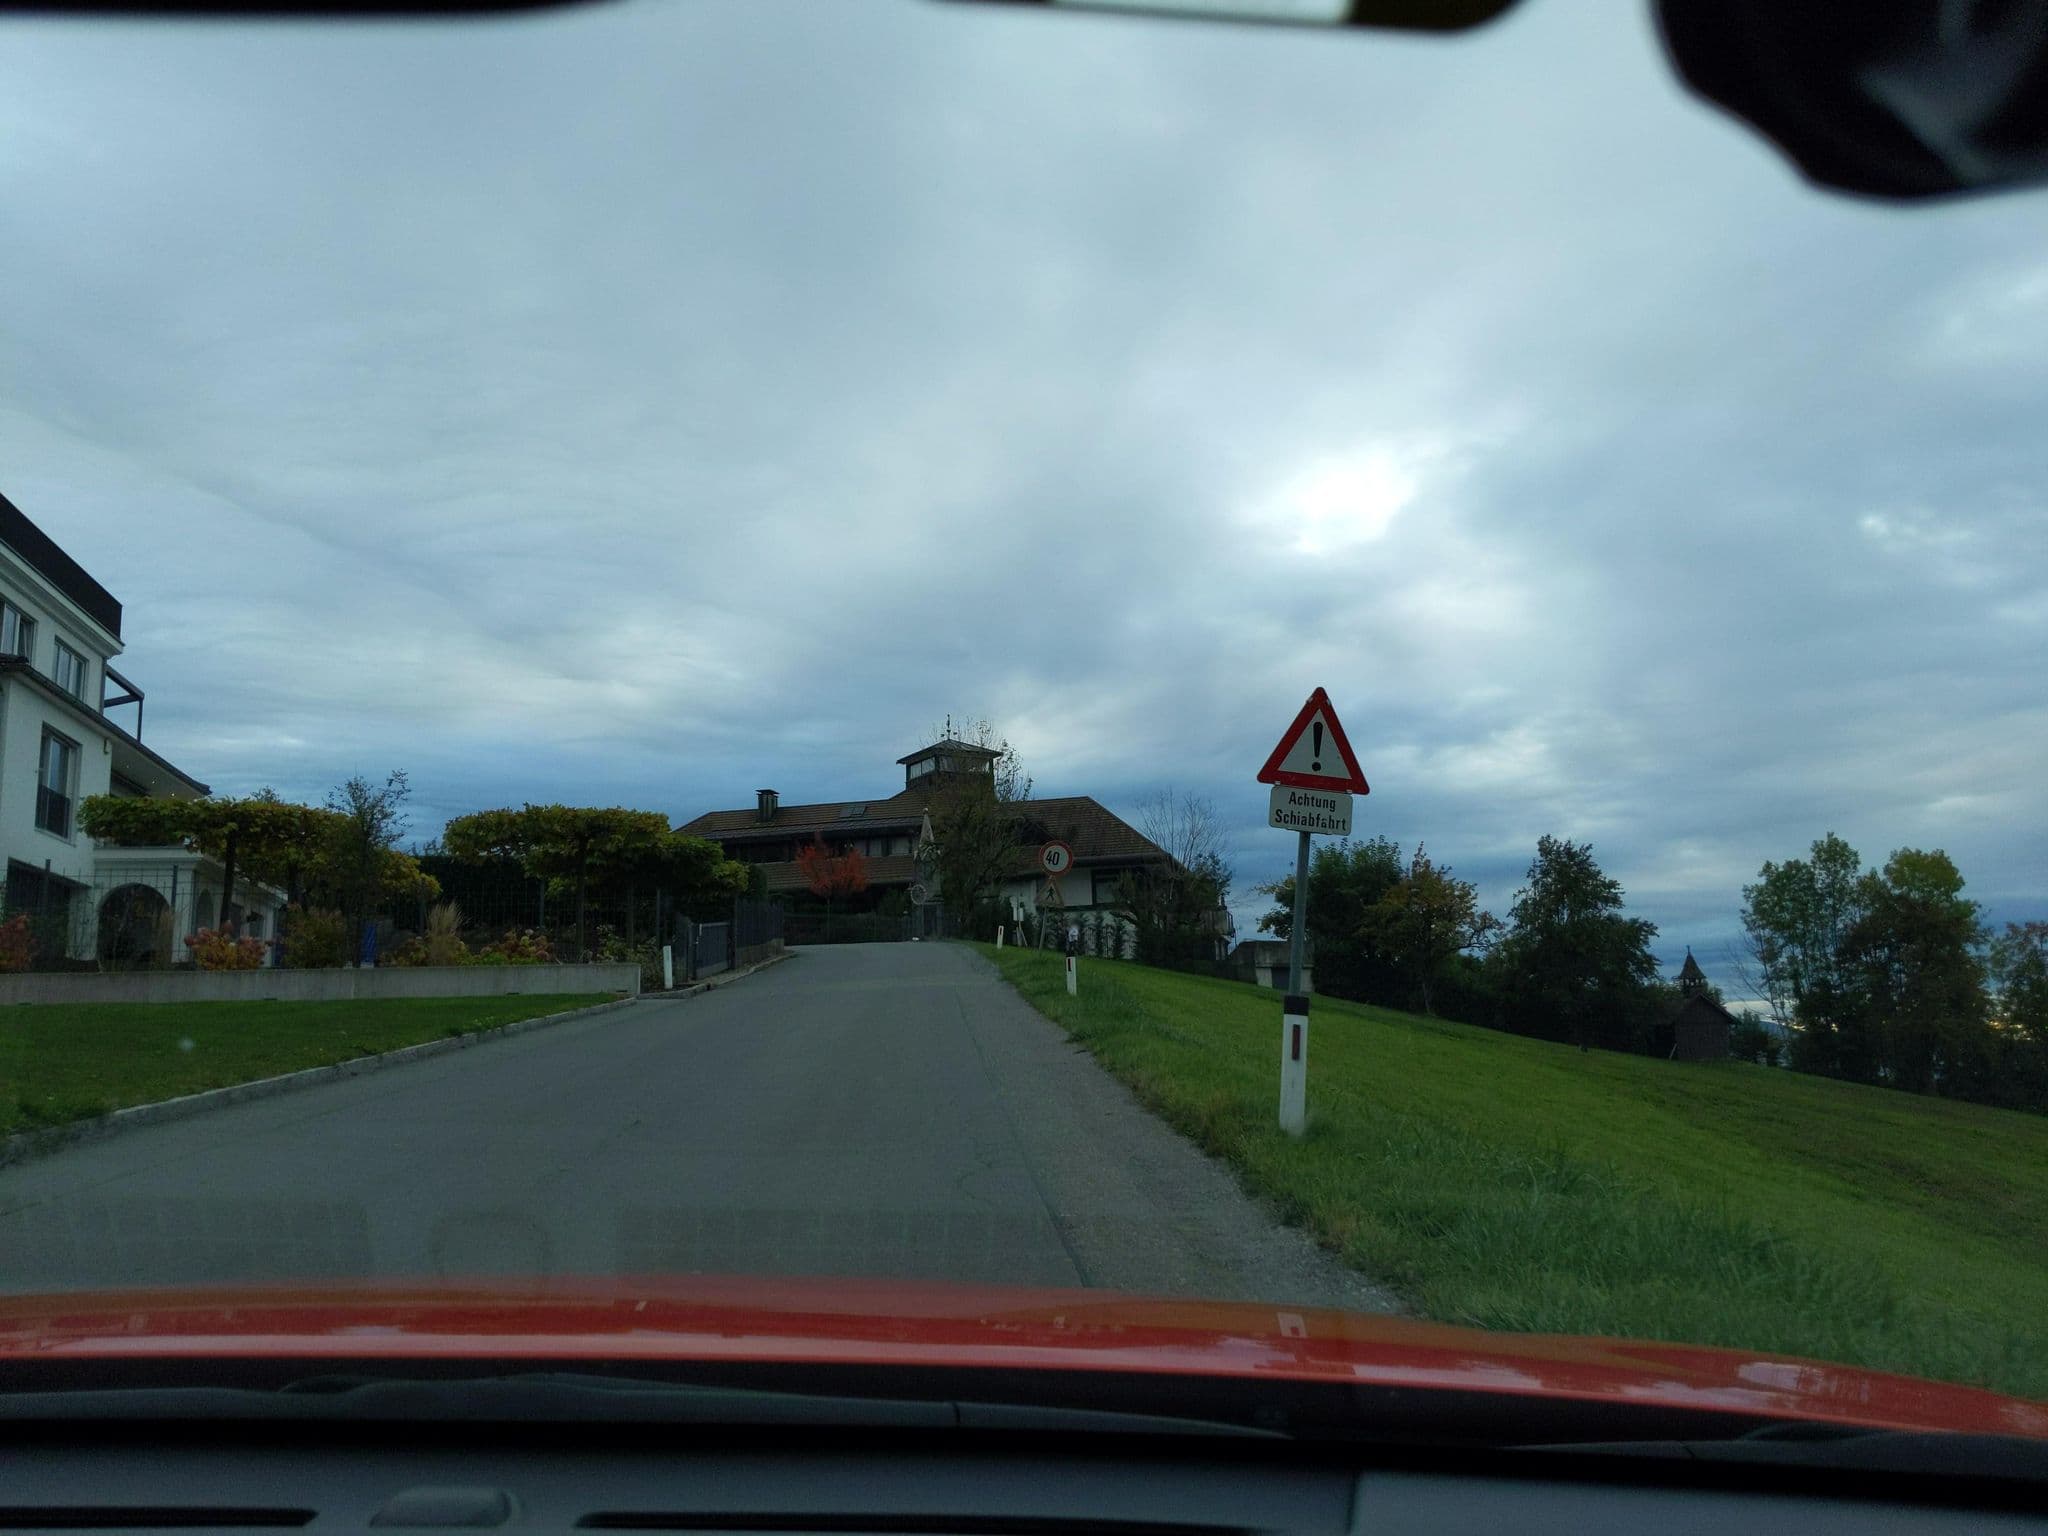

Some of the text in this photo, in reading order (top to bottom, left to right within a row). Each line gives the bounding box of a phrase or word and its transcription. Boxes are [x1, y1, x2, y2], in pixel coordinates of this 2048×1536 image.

[1288, 791, 1336, 812] Achtung
[1275, 809, 1346, 831] Schiabfahrt
[1045, 850, 1060, 865] 40
